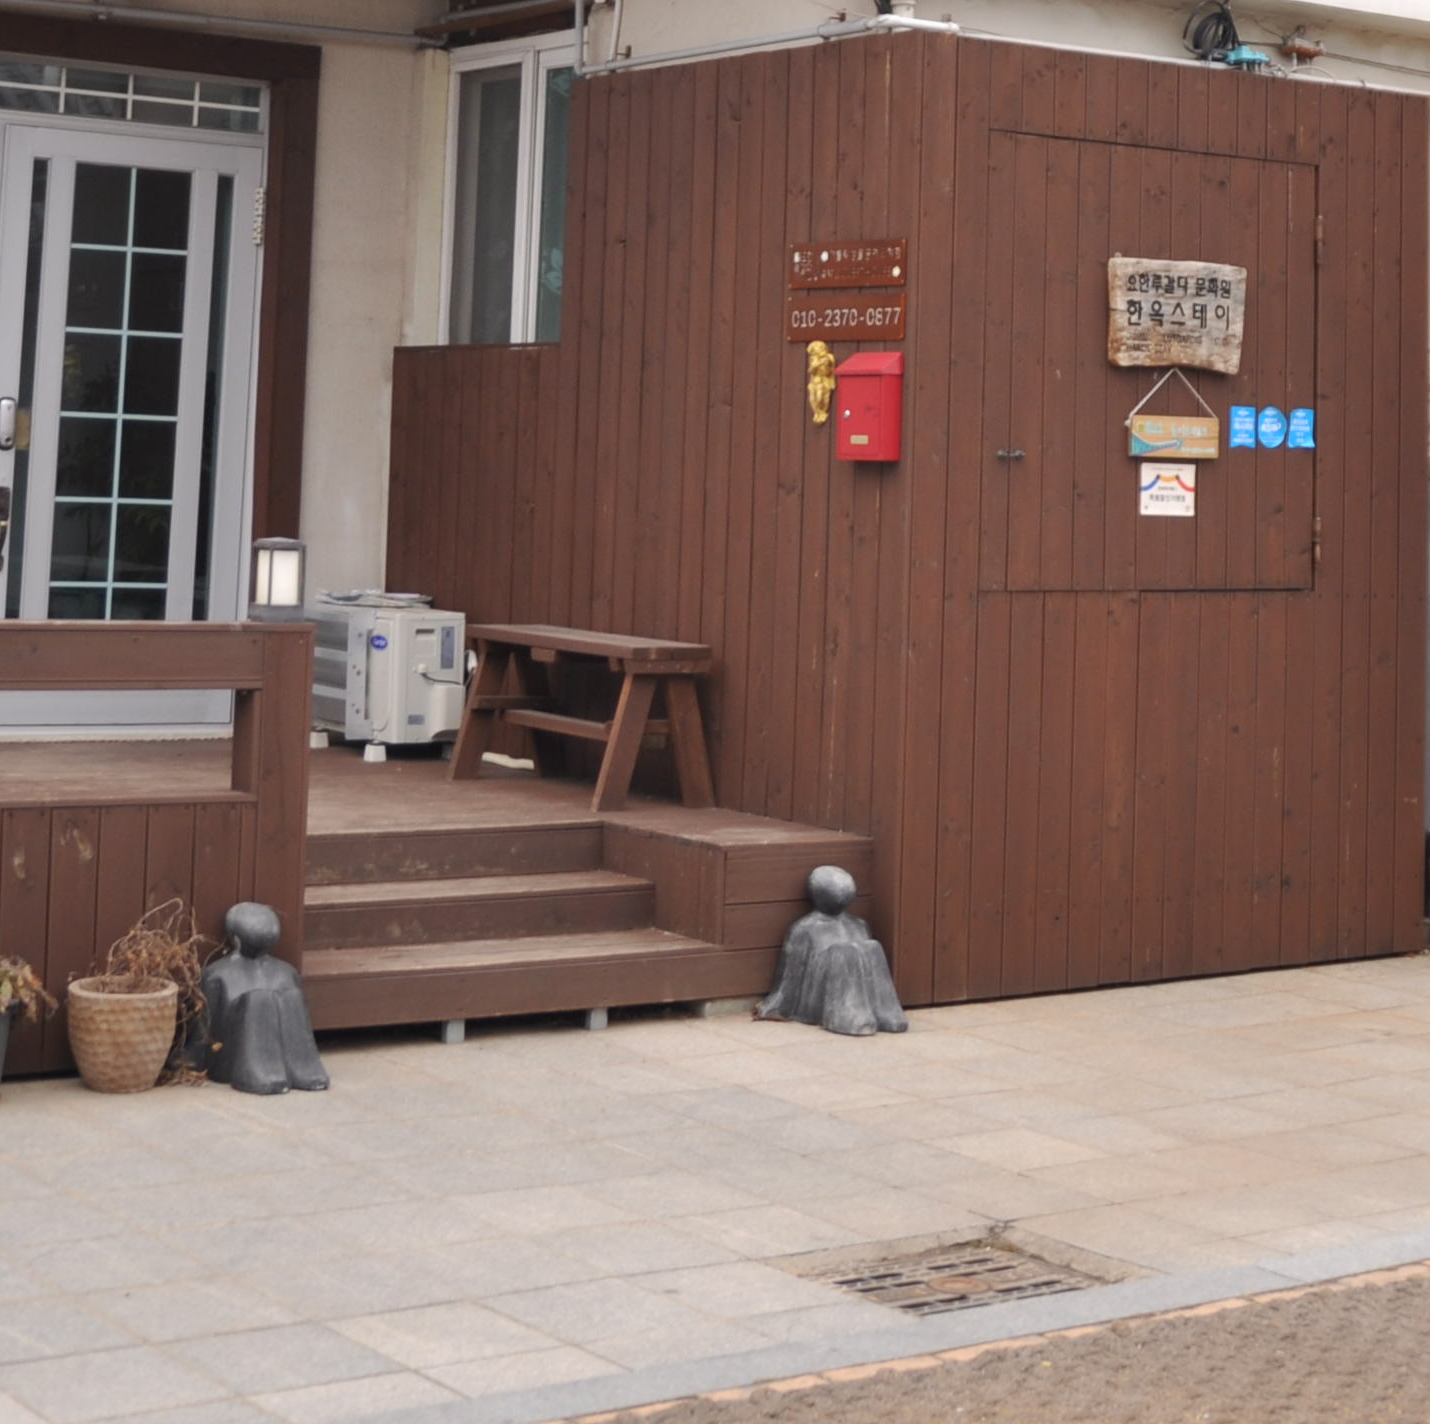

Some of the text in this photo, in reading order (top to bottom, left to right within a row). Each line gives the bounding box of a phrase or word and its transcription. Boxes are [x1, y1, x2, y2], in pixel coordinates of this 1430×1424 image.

[1194, 277, 1231, 299] 문화원
[792, 307, 901, 328] 010-2370-0877
[1126, 298, 1230, 331] 한옥스테이
